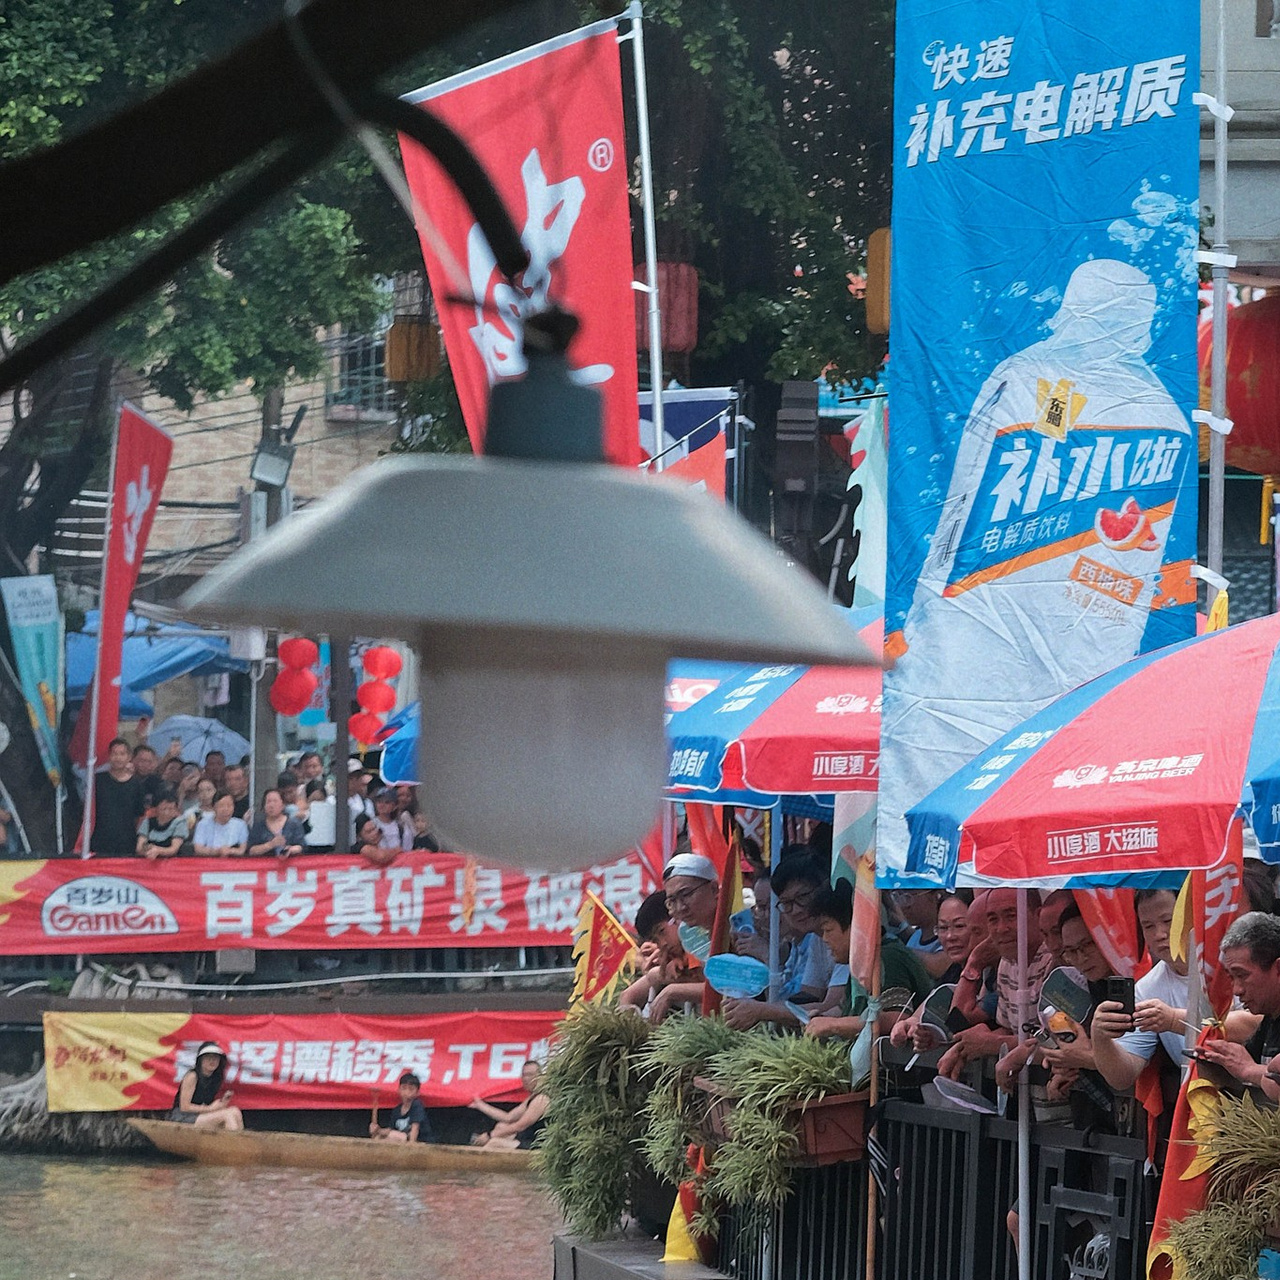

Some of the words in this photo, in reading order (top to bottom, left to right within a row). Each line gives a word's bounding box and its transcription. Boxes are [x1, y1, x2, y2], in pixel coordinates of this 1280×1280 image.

[932, 35, 1014, 91] 快速
[905, 54, 1187, 168] 补充电解质
[990, 436, 1182, 522] 补水啦
[980, 511, 1072, 553] 电解质饮料
[1077, 560, 1135, 600] 西柚味
[812, 755, 866, 777] 小度酒
[1109, 771, 1162, 784] YANJING
[1163, 767, 1196, 780] BEER
[1111, 753, 1205, 776] 燕京啤酒
[1047, 830, 1101, 859] 小度酒
[1104, 825, 1159, 854] 大滋味
[65, 886, 140, 905] 百岁山
[200, 866, 508, 939] 百岁真矿泉
[49, 904, 166, 933] Ganten
